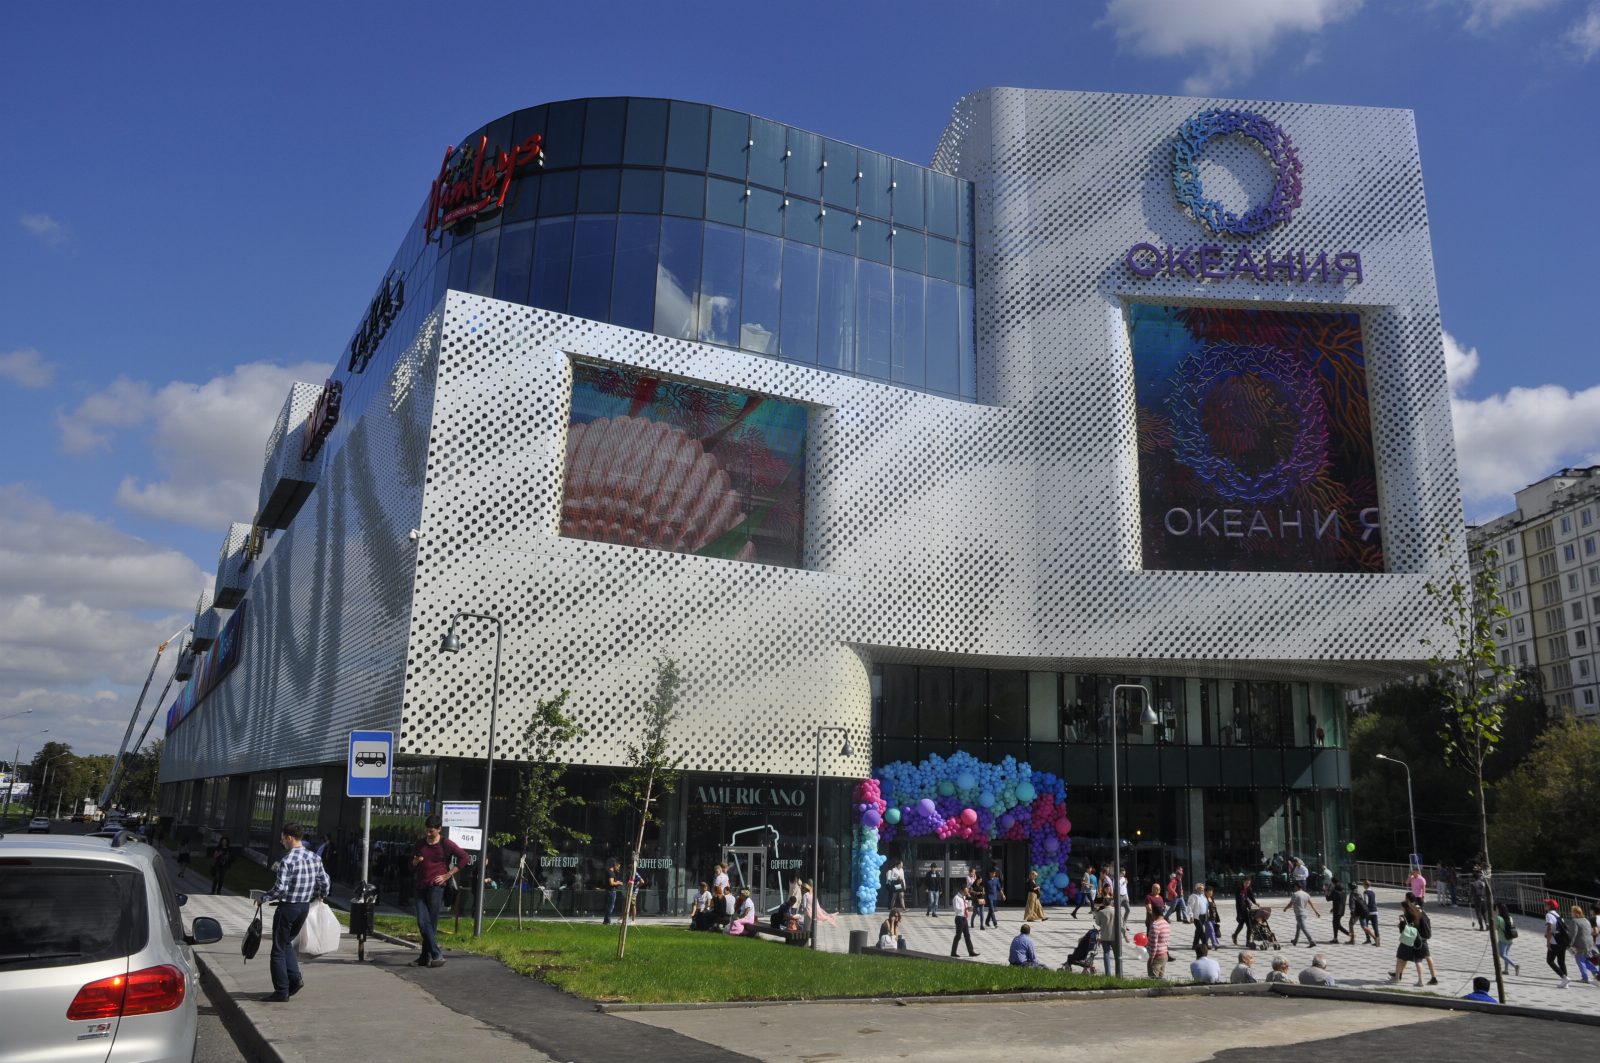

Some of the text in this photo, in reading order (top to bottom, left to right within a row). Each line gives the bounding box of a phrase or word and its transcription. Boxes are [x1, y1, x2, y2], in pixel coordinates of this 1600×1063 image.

[424, 133, 543, 245] Hamleys
[1126, 241, 1364, 284] ОКЕАНИЯ
[695, 786, 806, 806] AMERICANO
[461, 834, 475, 842] 464
[562, 856, 579, 868] STOP
[657, 858, 673, 869] STOP
[770, 859, 789, 870] COFFEE
[789, 859, 803, 870] STOP
[87, 1022, 112, 1033] TSI
